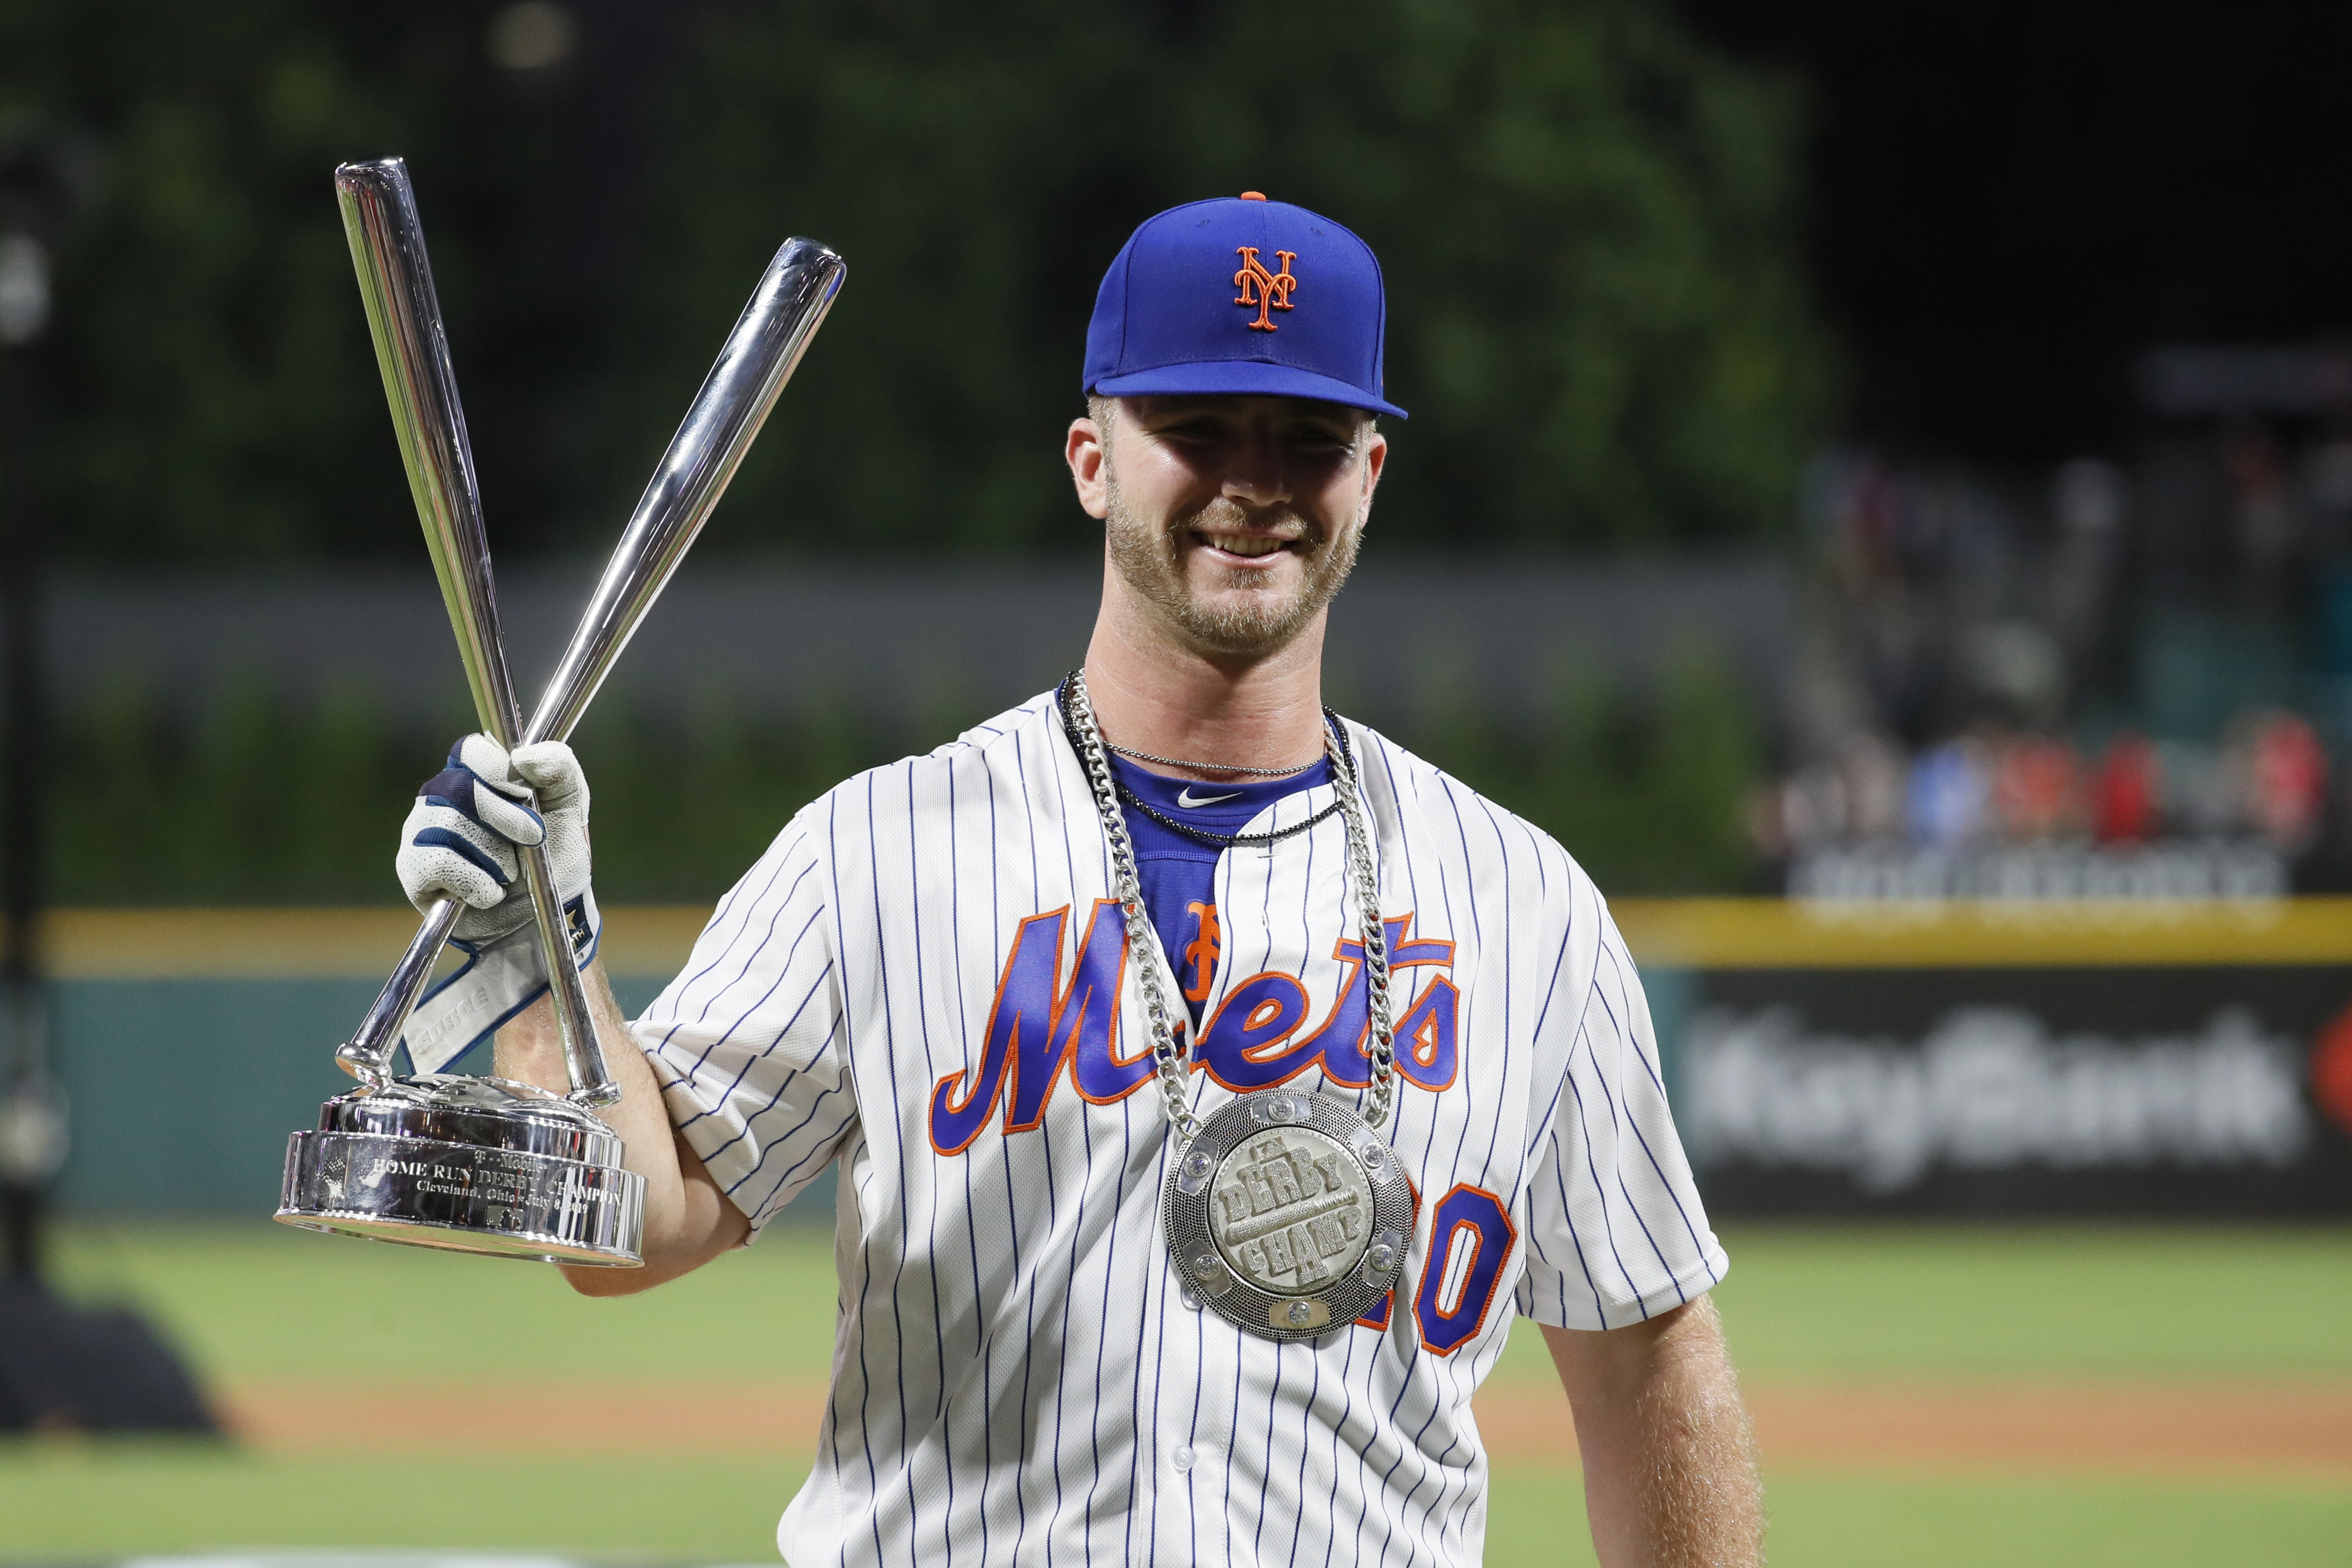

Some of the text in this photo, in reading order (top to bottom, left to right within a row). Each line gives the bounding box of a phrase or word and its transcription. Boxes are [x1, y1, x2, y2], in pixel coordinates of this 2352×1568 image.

[928, 898, 1460, 1157] Mets
[373, 1158, 622, 1206] HOME RUN DERBY CHAMPION
[486, 1188, 515, 1202] Ohio
[525, 1194, 550, 1210] July
[566, 1198, 588, 1213] 2019
[1218, 1146, 1343, 1221] DERBY
[1239, 1206, 1363, 1287] CHAMP
